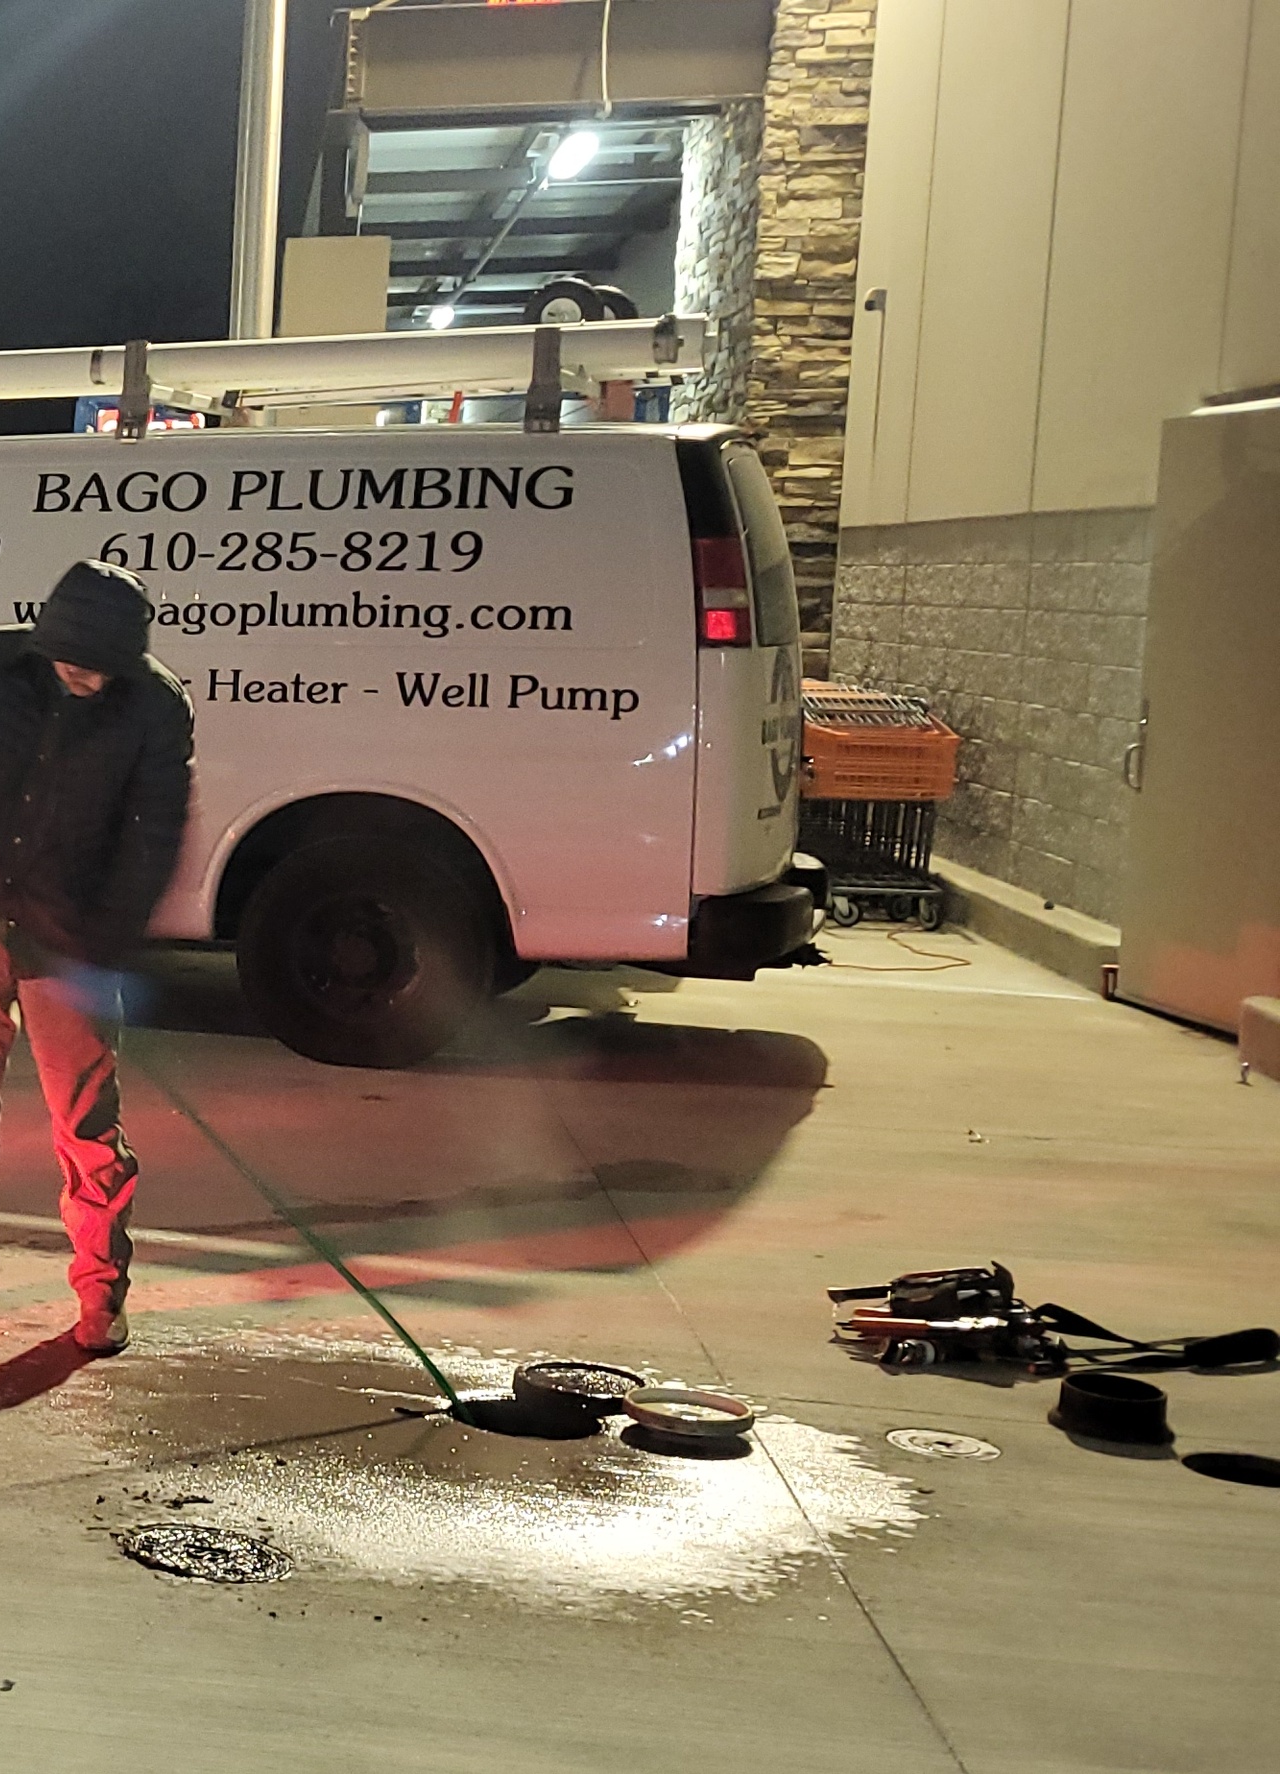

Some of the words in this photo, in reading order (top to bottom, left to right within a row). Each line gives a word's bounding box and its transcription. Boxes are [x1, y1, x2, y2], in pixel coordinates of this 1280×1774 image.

[32, 471, 207, 513] BAGO
[228, 465, 574, 511] PLUMBING
[99, 531, 484, 572] 610-285-8219
[207, 668, 349, 704] Heater
[396, 671, 490, 708] Well
[507, 674, 640, 721] Pump
